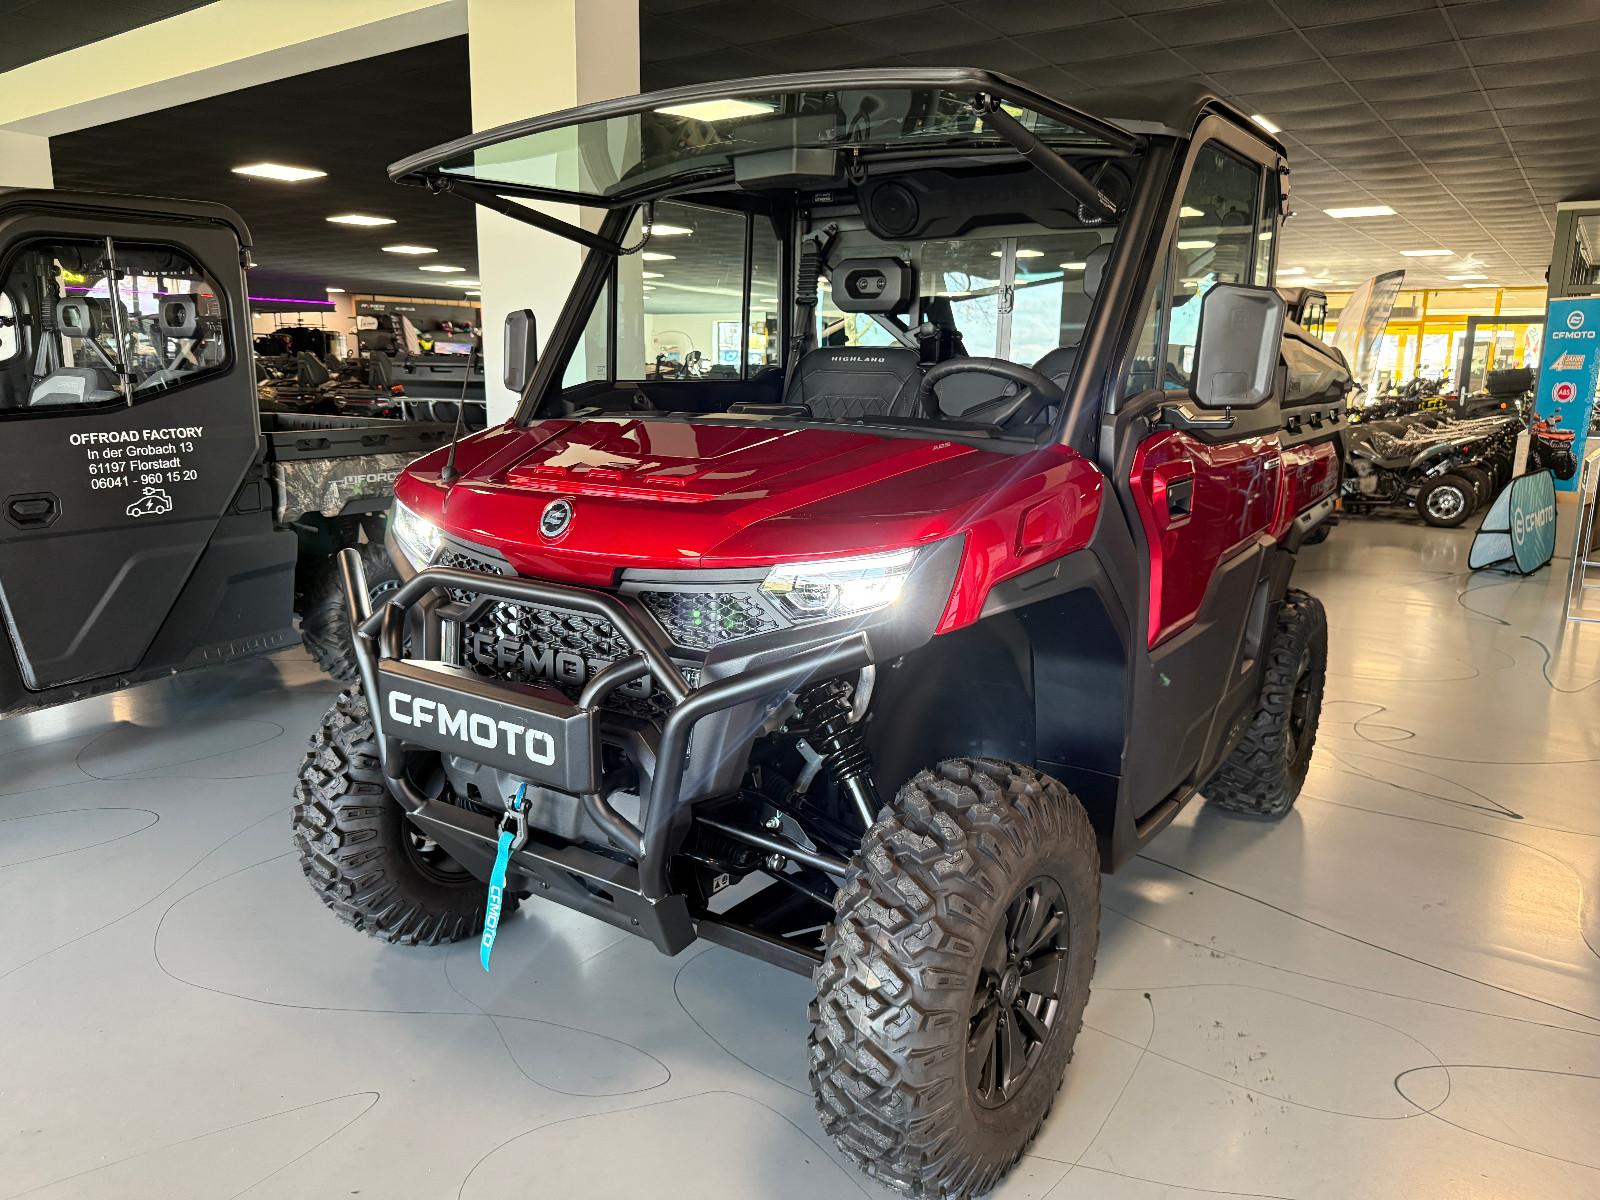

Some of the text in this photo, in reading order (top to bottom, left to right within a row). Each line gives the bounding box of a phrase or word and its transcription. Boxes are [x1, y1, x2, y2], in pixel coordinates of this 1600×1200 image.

[1552, 331, 1595, 339] CFMOTO
[1558, 388, 1570, 396] ABS
[69, 426, 204, 445] OFFROAD FACTORY
[87, 441, 194, 460] In der Grobach 13
[89, 457, 181, 475] 61197 Florstadt
[91, 476, 129, 490] 06041
[140, 473, 163, 485] 960
[166, 471, 180, 483] 15
[183, 469, 198, 481] 20
[344, 471, 400, 485] UFORC
[1525, 505, 1553, 532] CFMOTO
[388, 690, 556, 766] CFMOTO
[483, 885, 501, 948] CFMOTO
